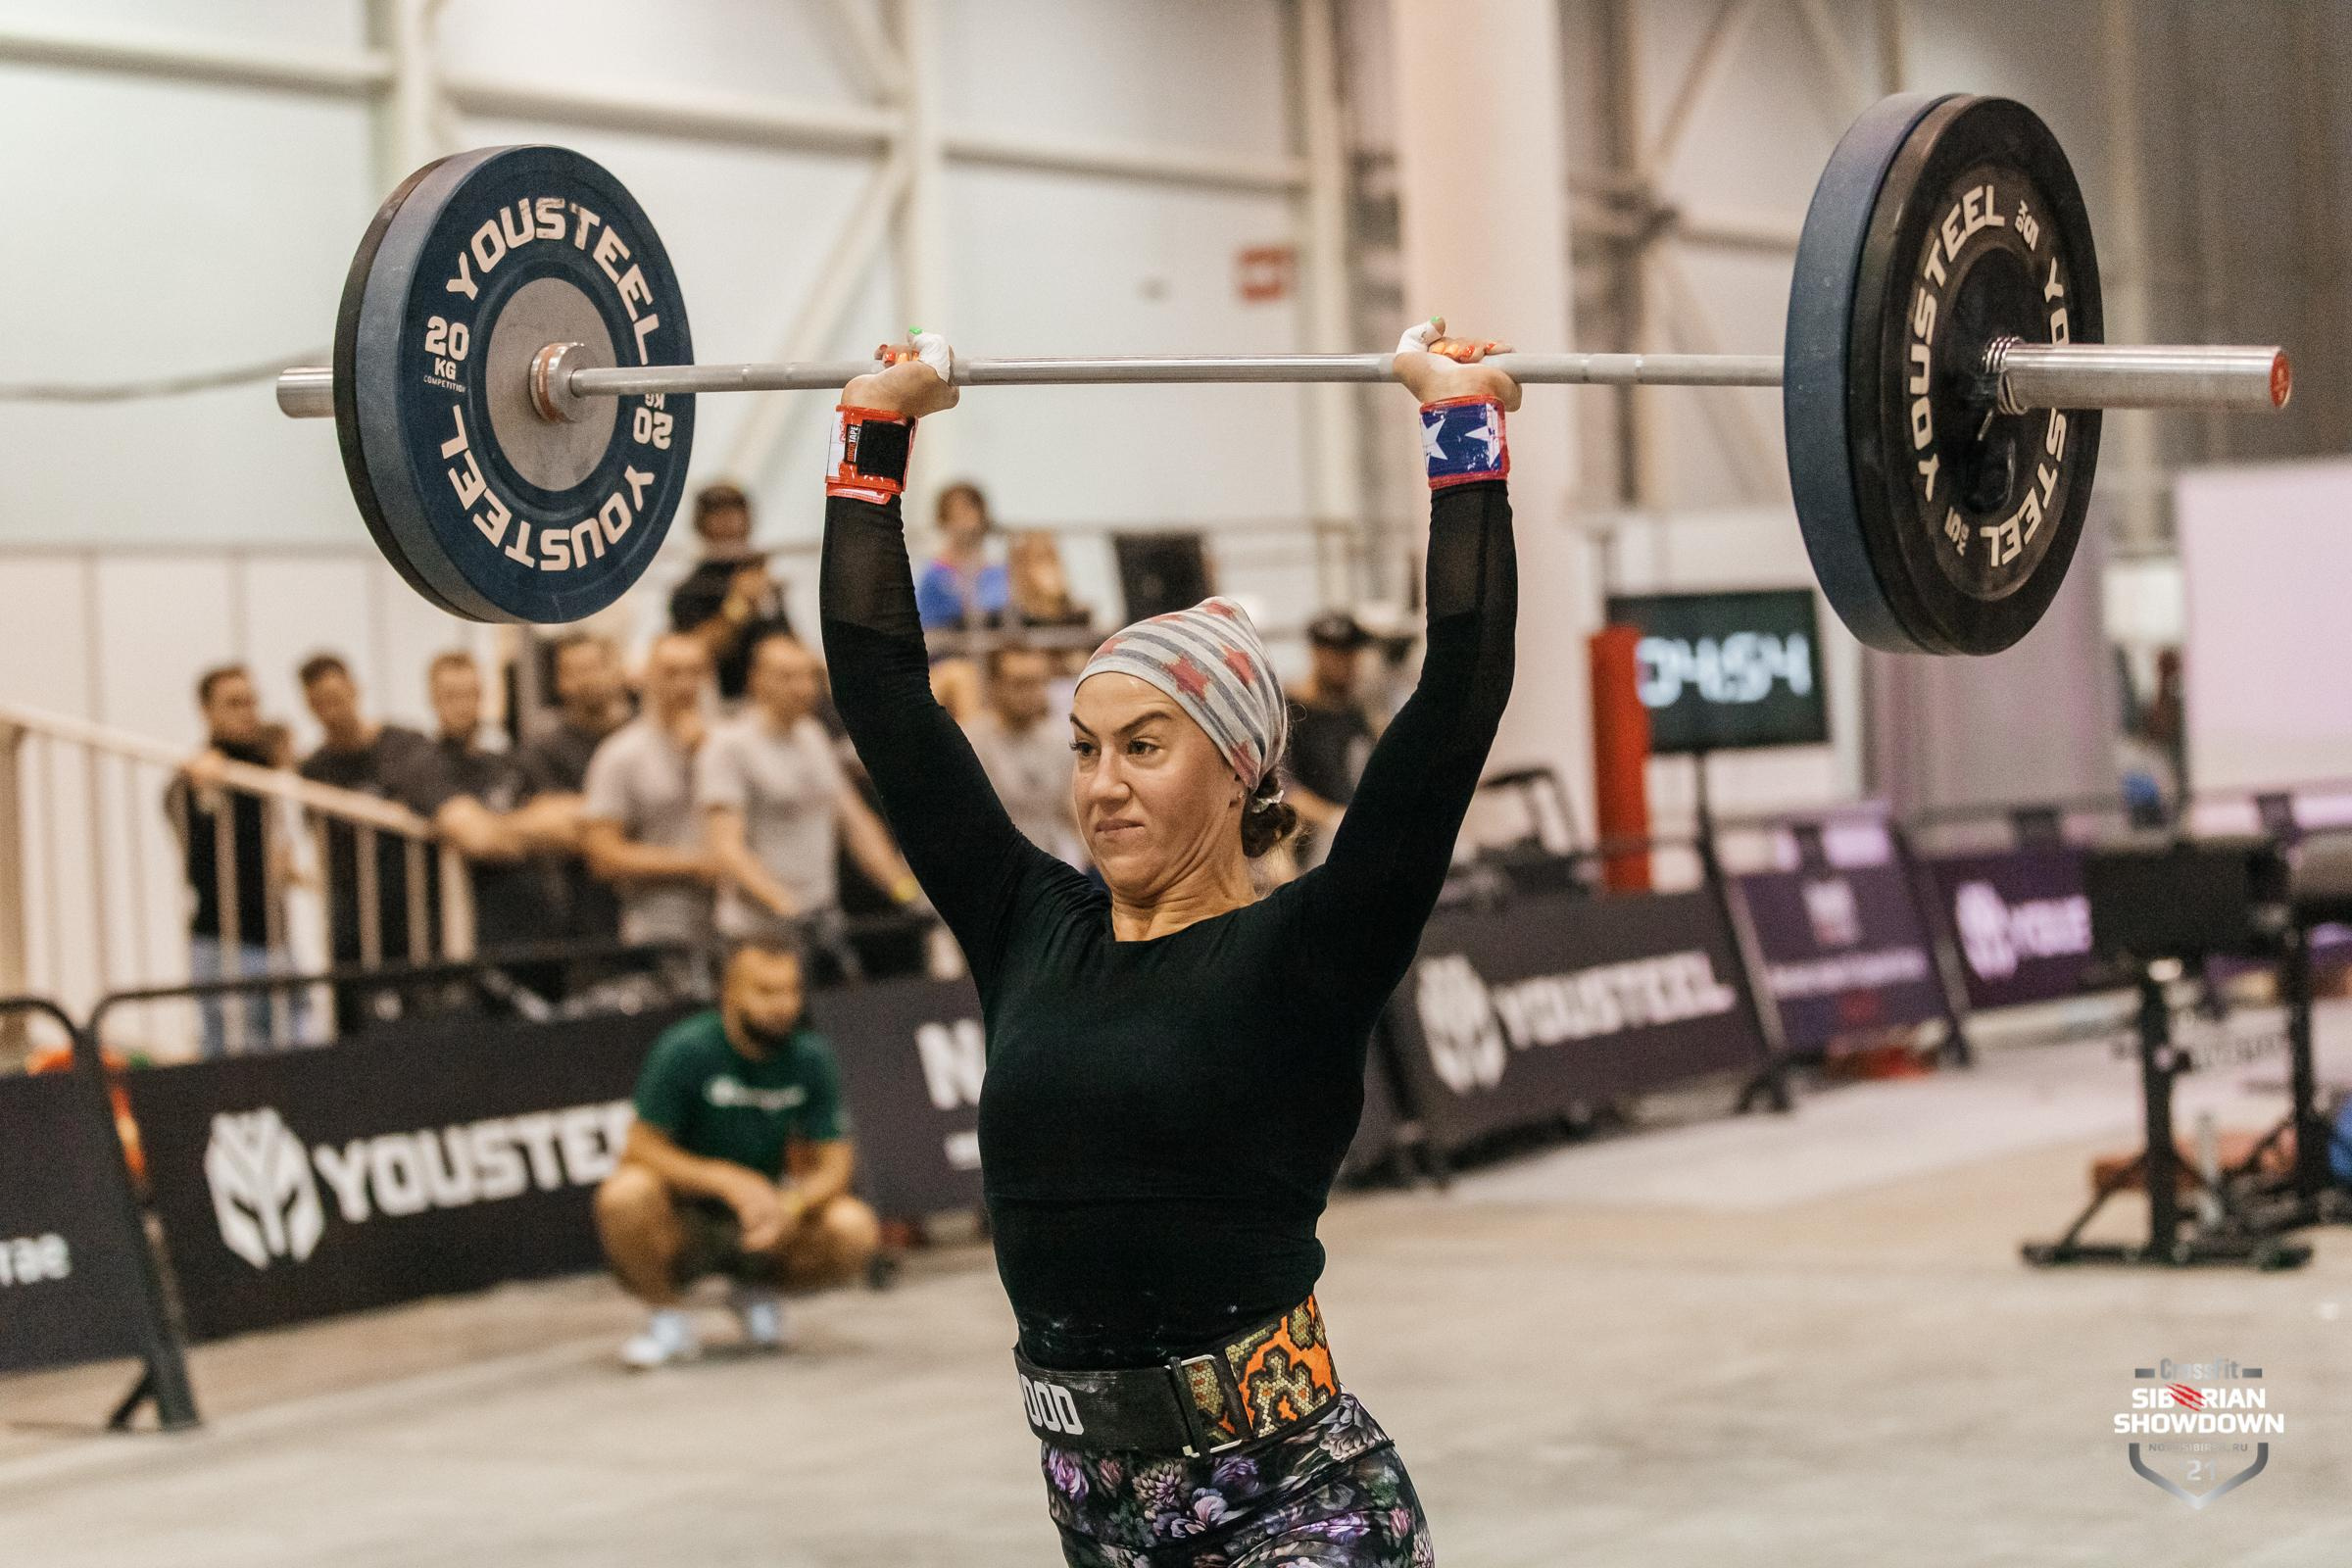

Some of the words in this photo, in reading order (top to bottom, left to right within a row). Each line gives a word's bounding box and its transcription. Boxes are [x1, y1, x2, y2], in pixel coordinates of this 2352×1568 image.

[424, 316, 469, 362] 20
[446, 197, 661, 365] YOUSTEEL
[1909, 185, 2005, 502] YOUSTEEL
[434, 357, 457, 380] KG
[633, 407, 673, 450] 20
[1979, 256, 2071, 567] YOSTEEL
[441, 404, 655, 572] YOUSTEEL
[315, 1100, 635, 1223] YOUSTE
